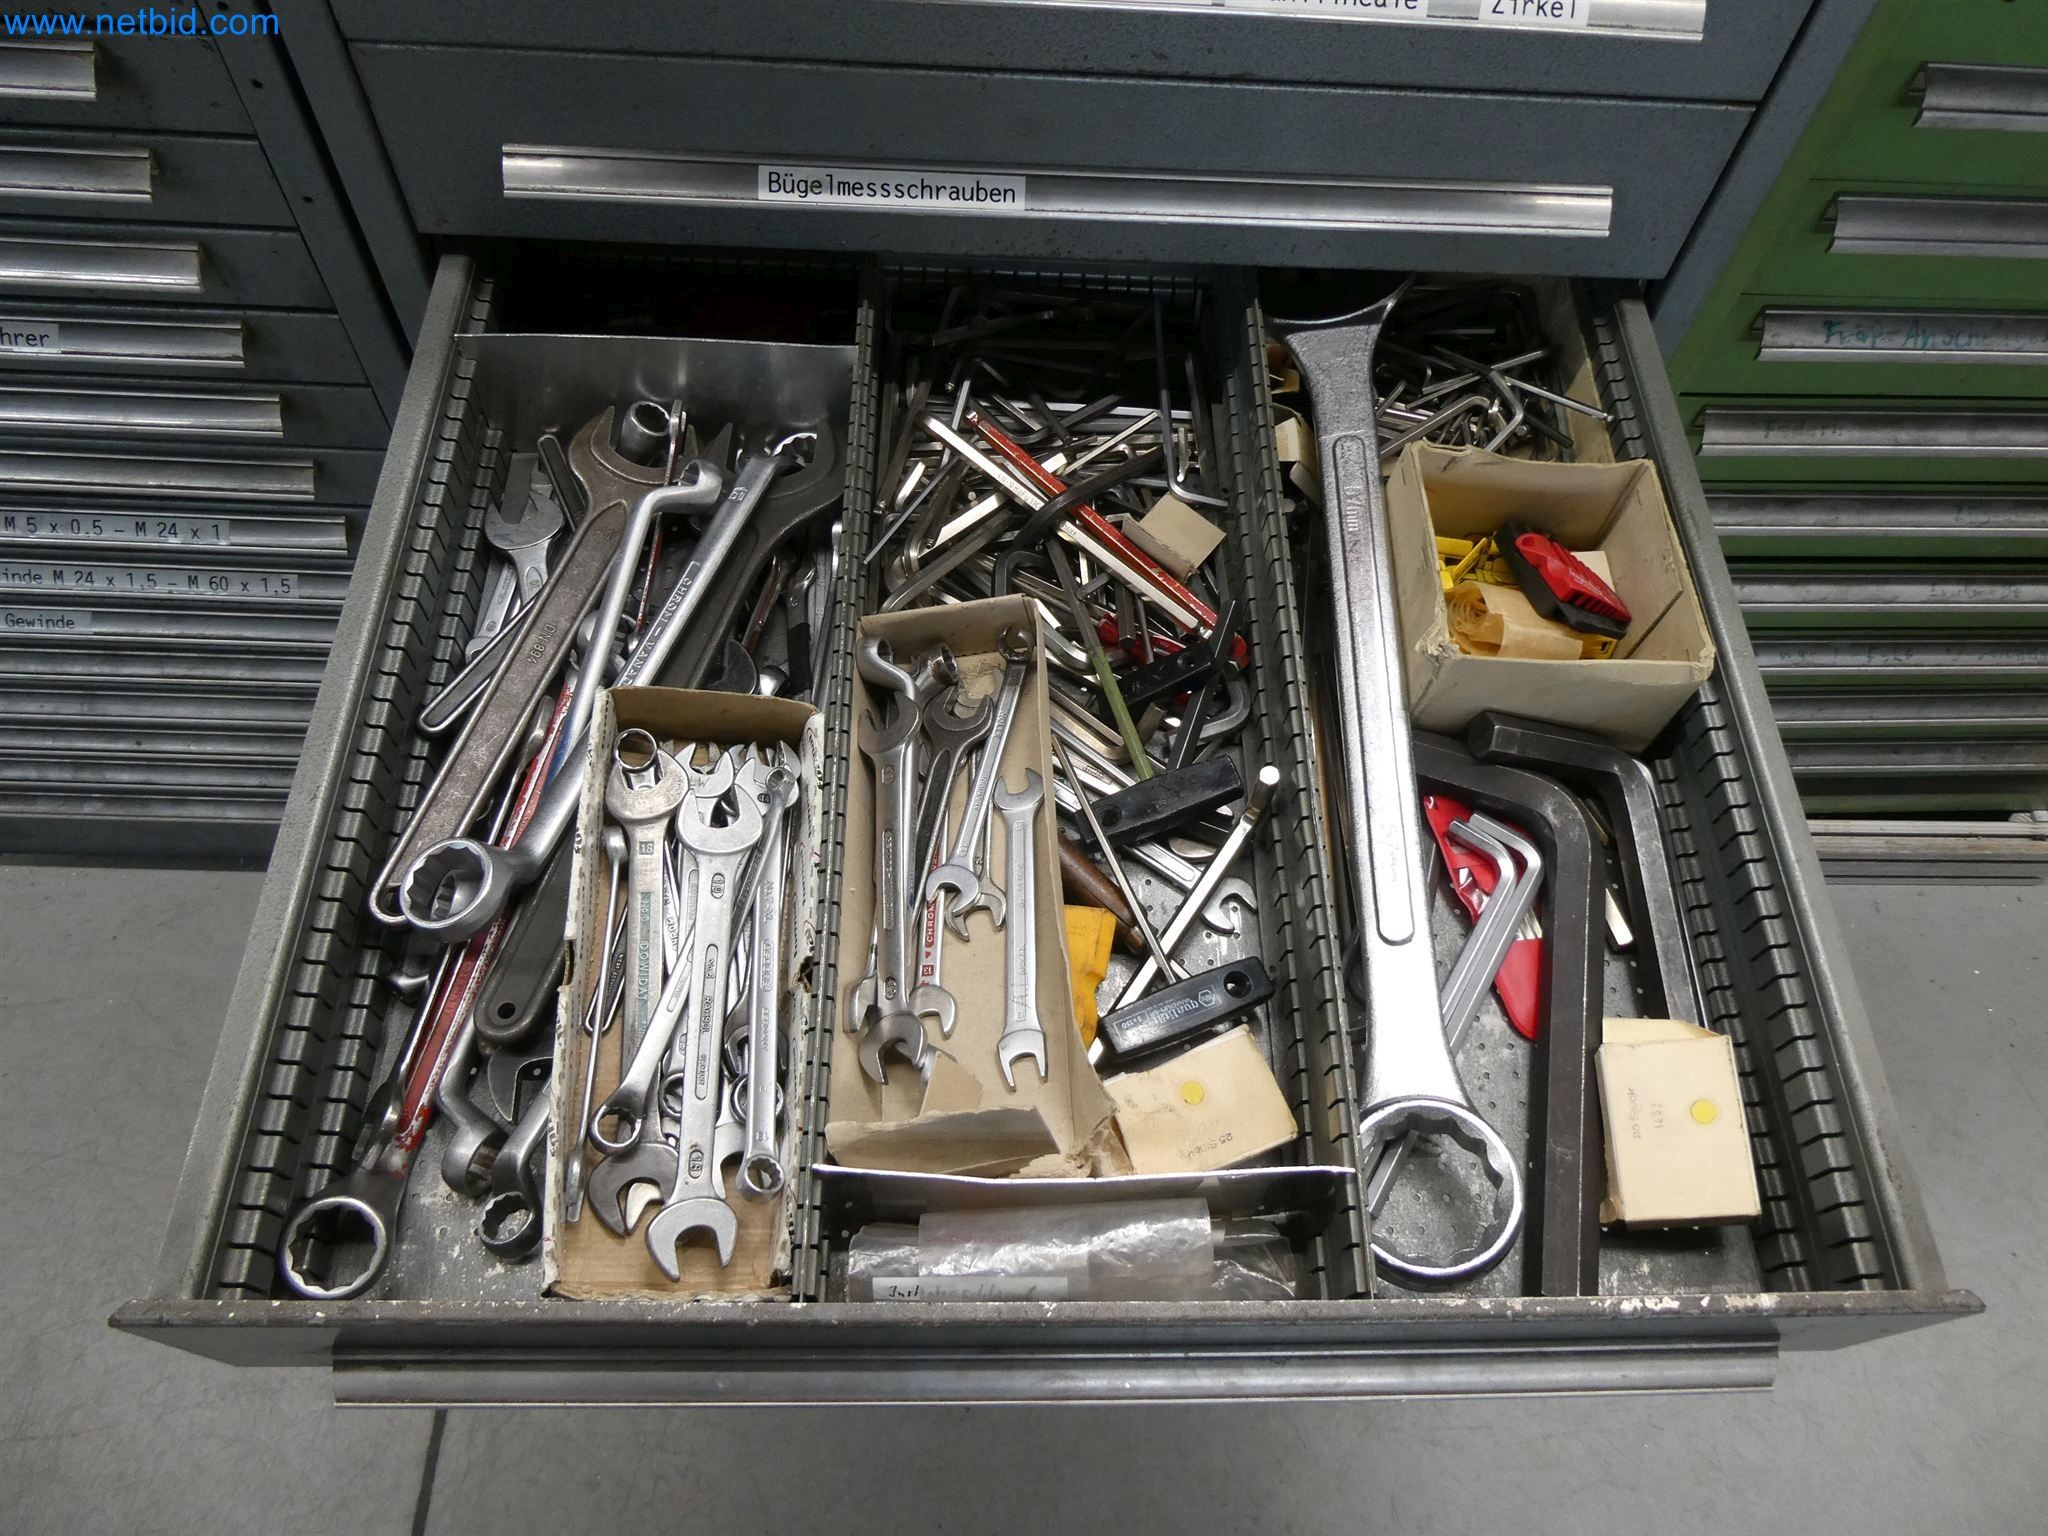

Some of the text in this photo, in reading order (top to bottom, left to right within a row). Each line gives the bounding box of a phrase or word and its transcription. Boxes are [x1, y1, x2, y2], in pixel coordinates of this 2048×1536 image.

[1492, 0, 1575, 18] Zirkel
[767, 171, 1017, 203] Bügelmessschrauben
[0, 326, 50, 347] hrer
[4, 516, 16, 533] M
[26, 517, 38, 533] 5
[135, 522, 147, 537] M
[157, 522, 179, 539] 24
[212, 524, 221, 540] 1
[2, 569, 43, 585] inde
[53, 570, 65, 584] M
[187, 575, 200, 589] M
[209, 576, 229, 592] 60
[261, 577, 291, 595] 1,5
[4, 613, 76, 630] Gewinde
[639, 842, 654, 854] 18
[712, 876, 725, 895] 19
[638, 940, 649, 1001] DOWIDAT
[690, 1154, 703, 1173] 18
